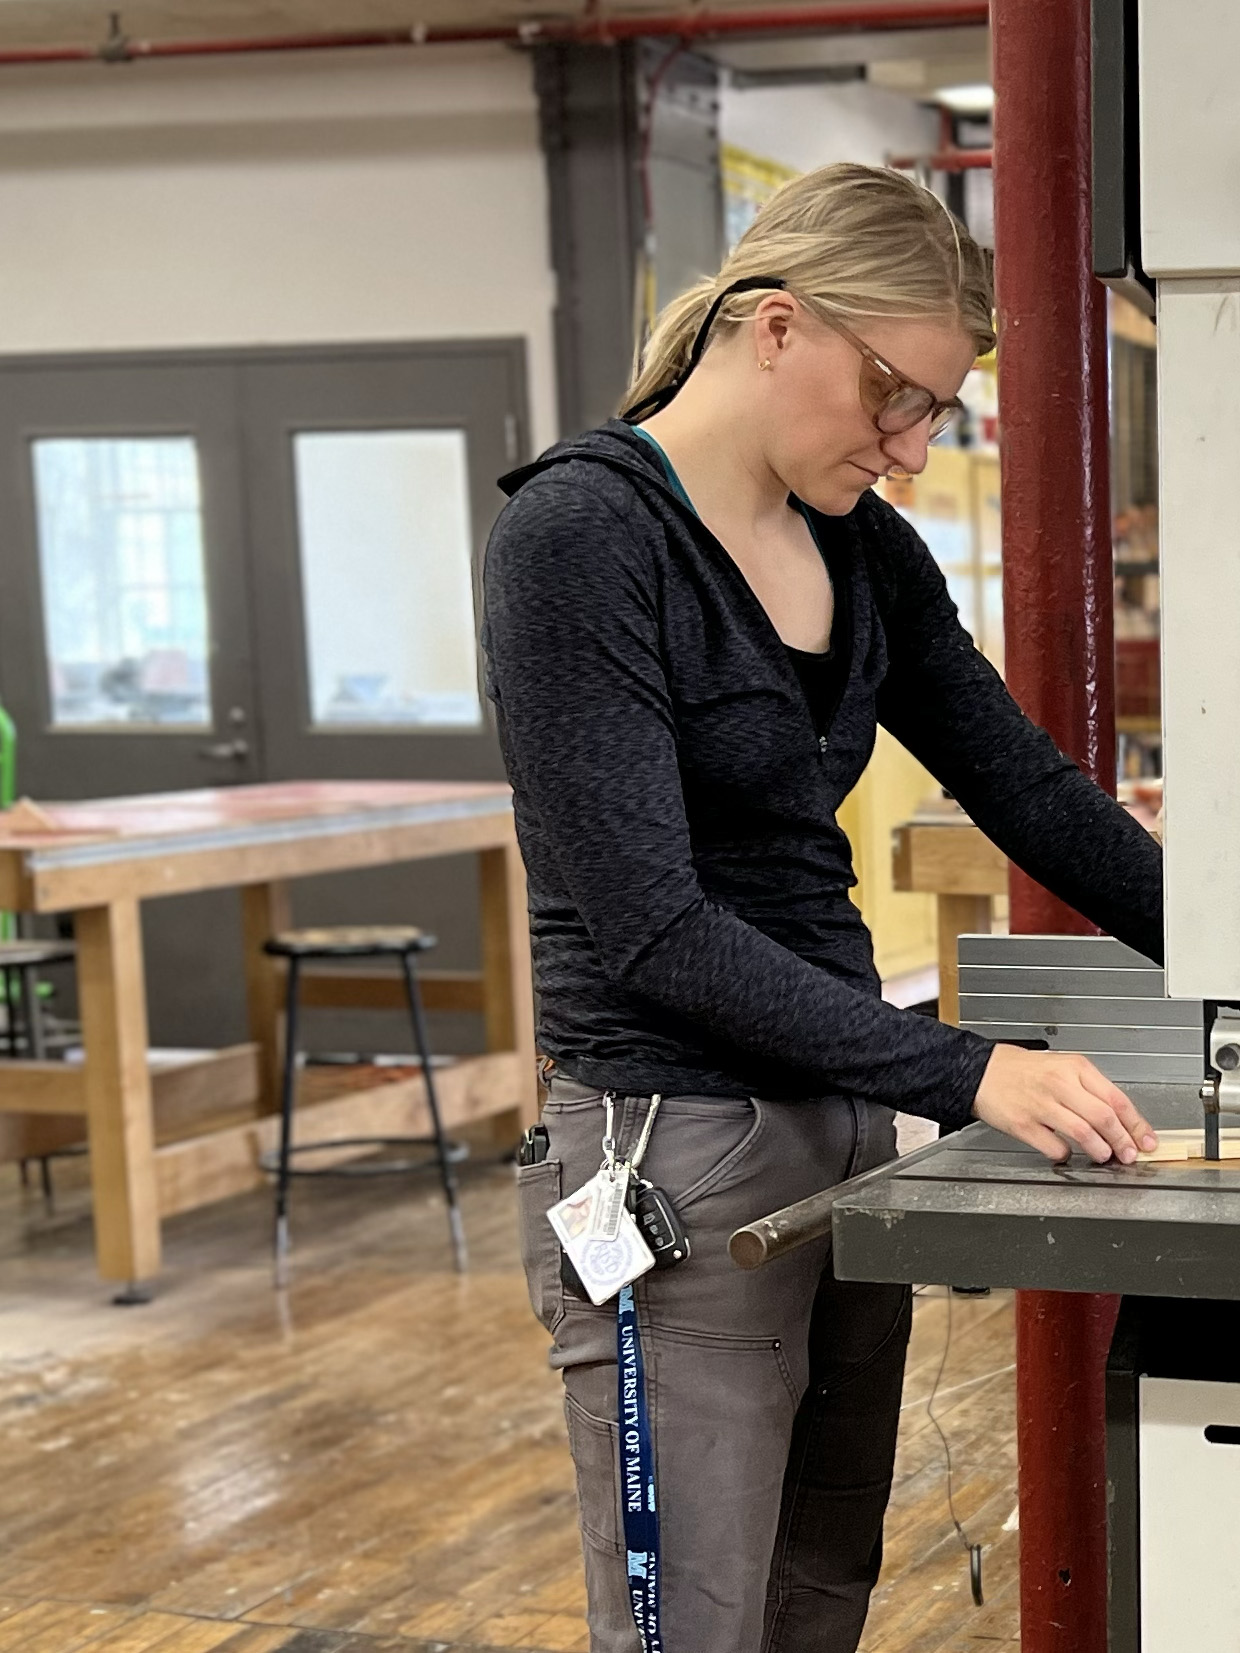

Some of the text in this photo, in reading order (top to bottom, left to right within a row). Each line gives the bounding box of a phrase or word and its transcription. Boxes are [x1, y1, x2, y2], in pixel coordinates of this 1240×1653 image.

[621, 1325, 642, 1513] UNIVERSITY OF MAINE
